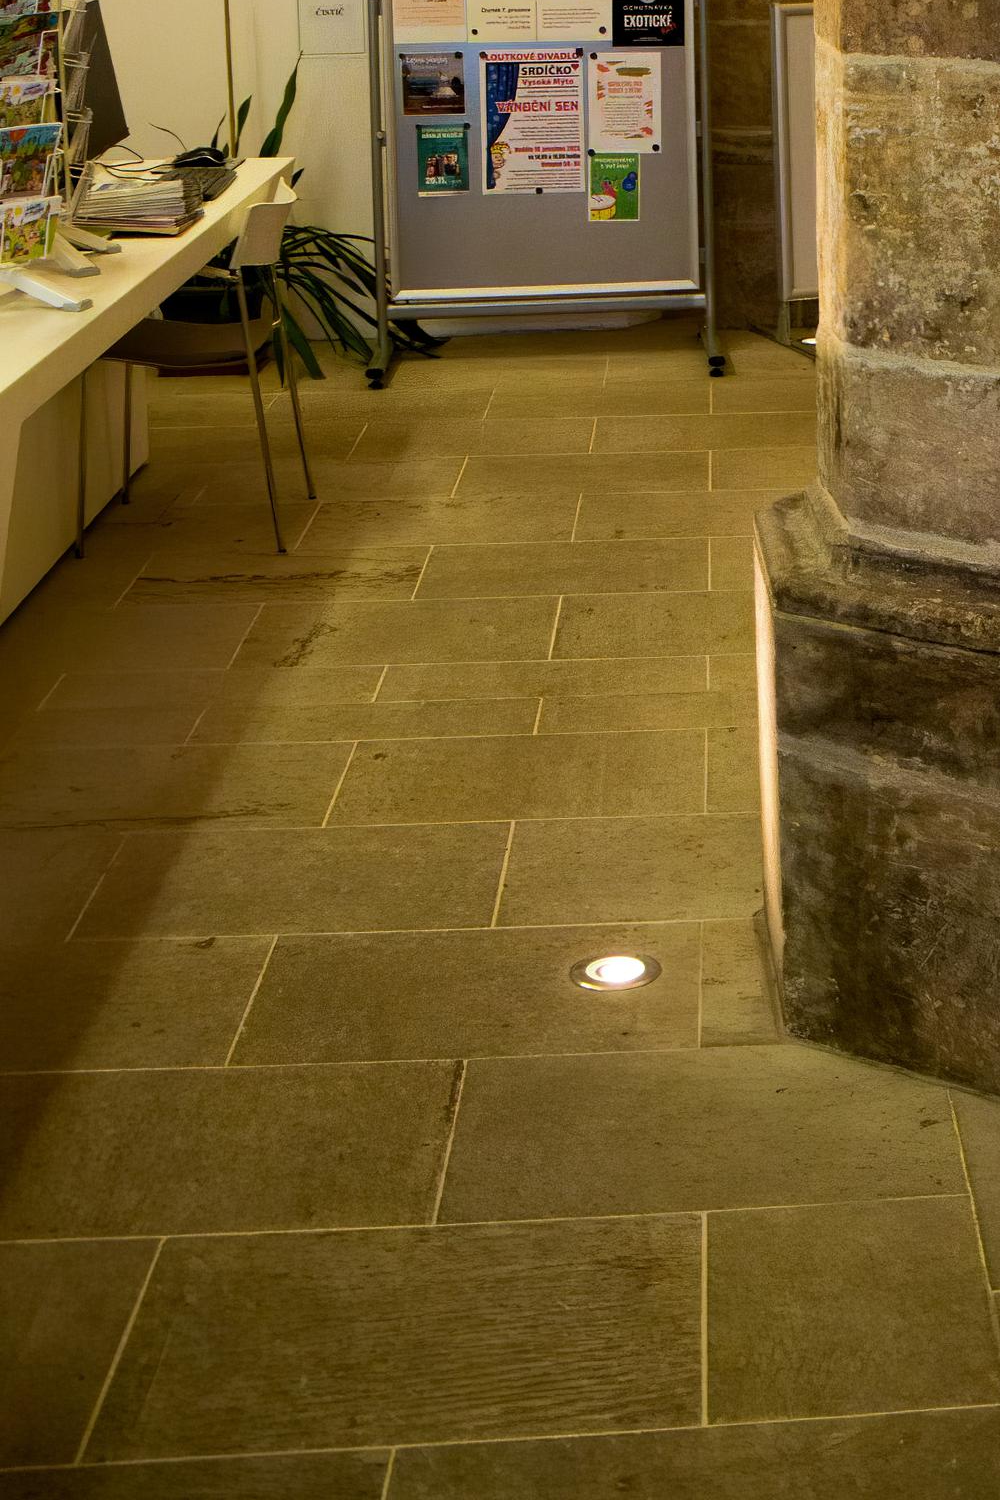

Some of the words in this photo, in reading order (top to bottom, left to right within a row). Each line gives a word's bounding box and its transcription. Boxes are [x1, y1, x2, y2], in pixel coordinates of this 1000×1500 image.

[624, 12, 673, 27] EXOTICKÉ
[485, 52, 535, 61] LOUTKOVÉ
[521, 64, 572, 75] SRDÍČKO
[555, 100, 579, 112] SEN
